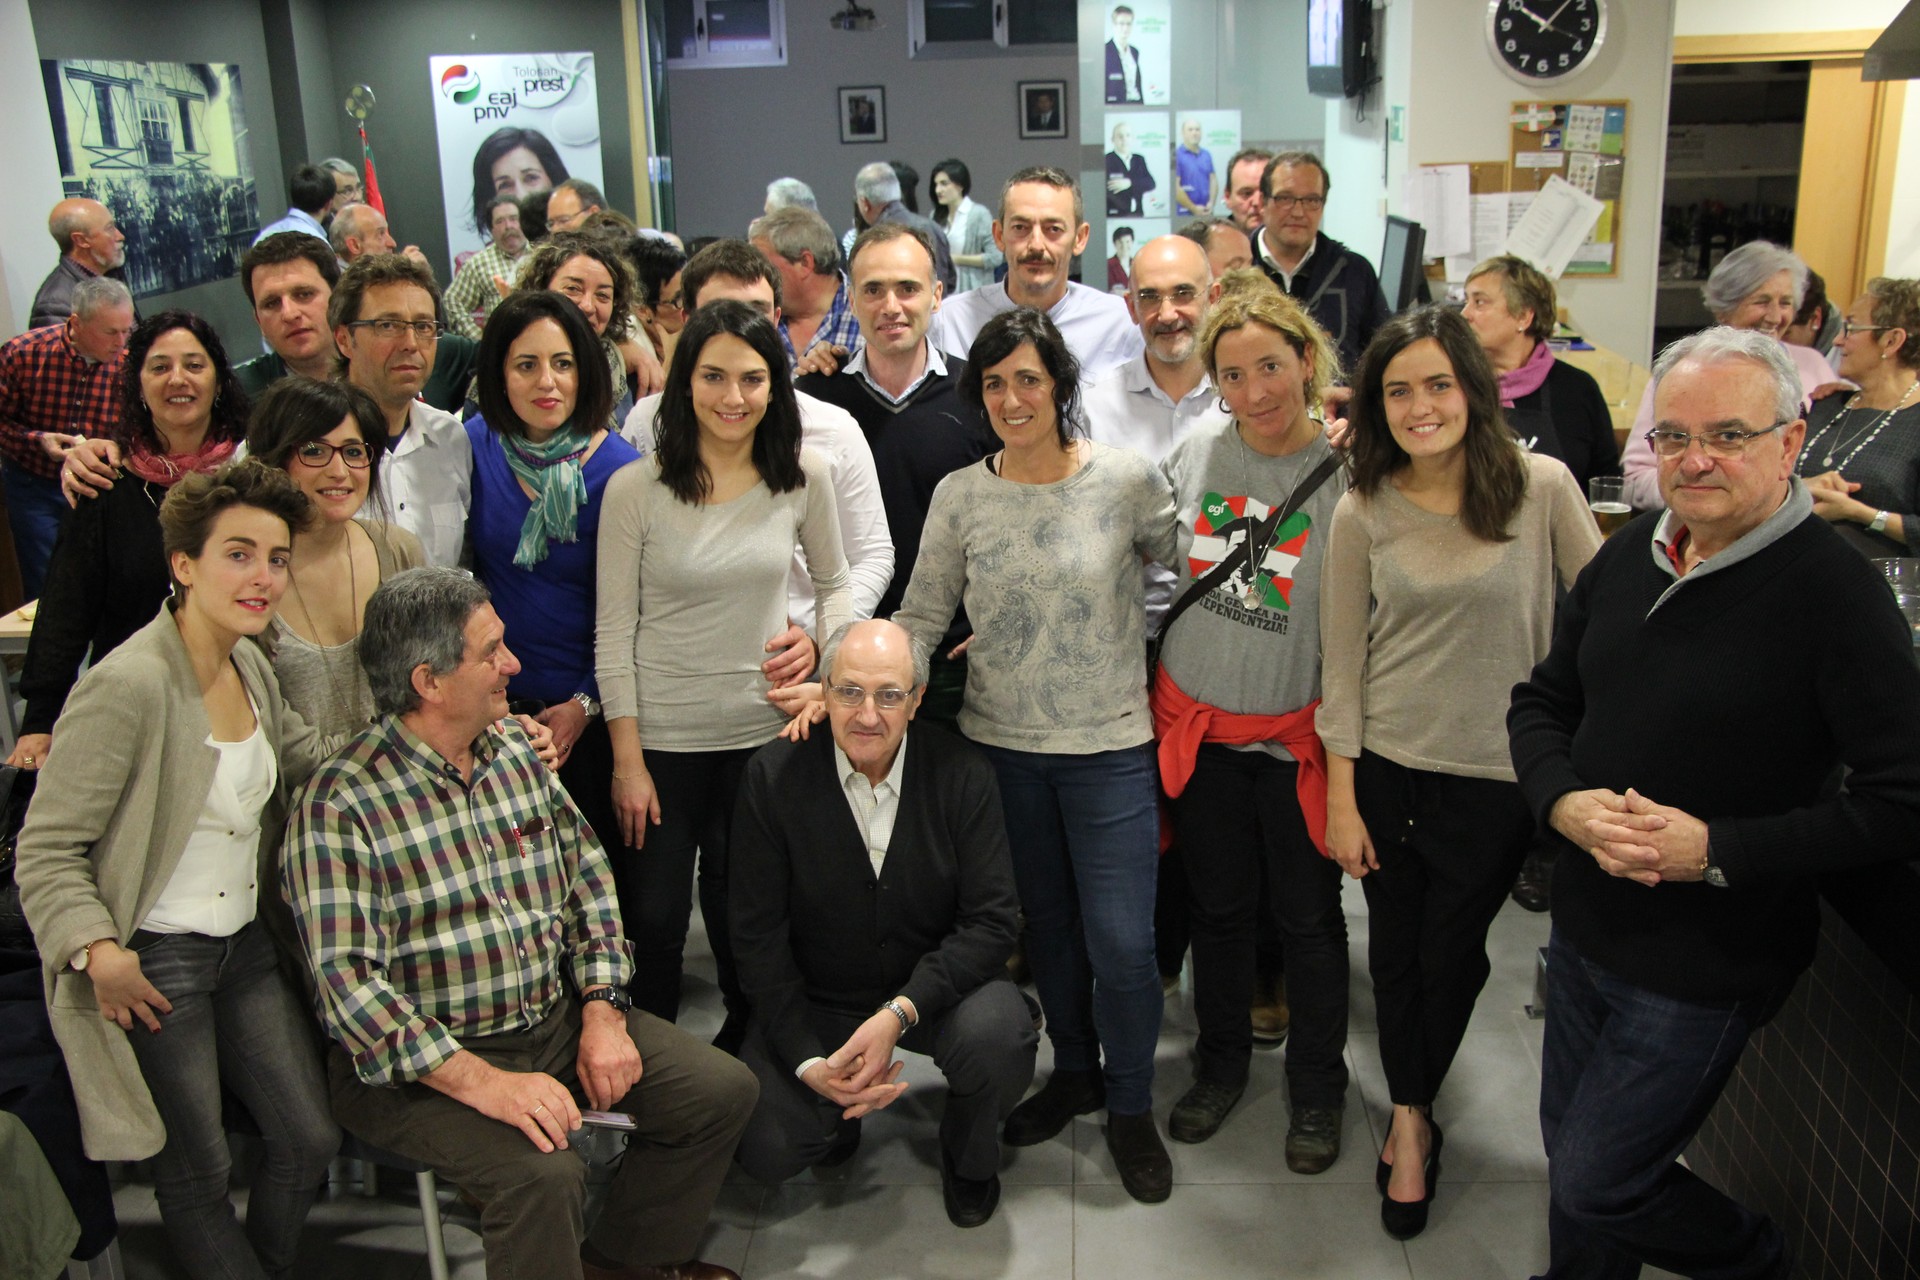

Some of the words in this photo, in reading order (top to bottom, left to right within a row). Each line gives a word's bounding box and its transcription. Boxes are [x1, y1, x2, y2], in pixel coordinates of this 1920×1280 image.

[1508, 0, 1523, 10] 10
[1576, 0, 1587, 11] 2
[1501, 18, 1512, 31] 9
[1580, 18, 1591, 31] 3
[1504, 39, 1517, 52] 8
[1572, 39, 1583, 52] 4
[1519, 54, 1530, 68] 7
[1536, 59, 1549, 73] 6
[1558, 53, 1570, 67] 5
[513, 66, 558, 78] Tolosan
[524, 75, 566, 96] prest
[488, 87, 518, 109] eaj
[474, 106, 510, 123] pnv
[1208, 501, 1229, 516] egi
[1273, 611, 1289, 624] DA
